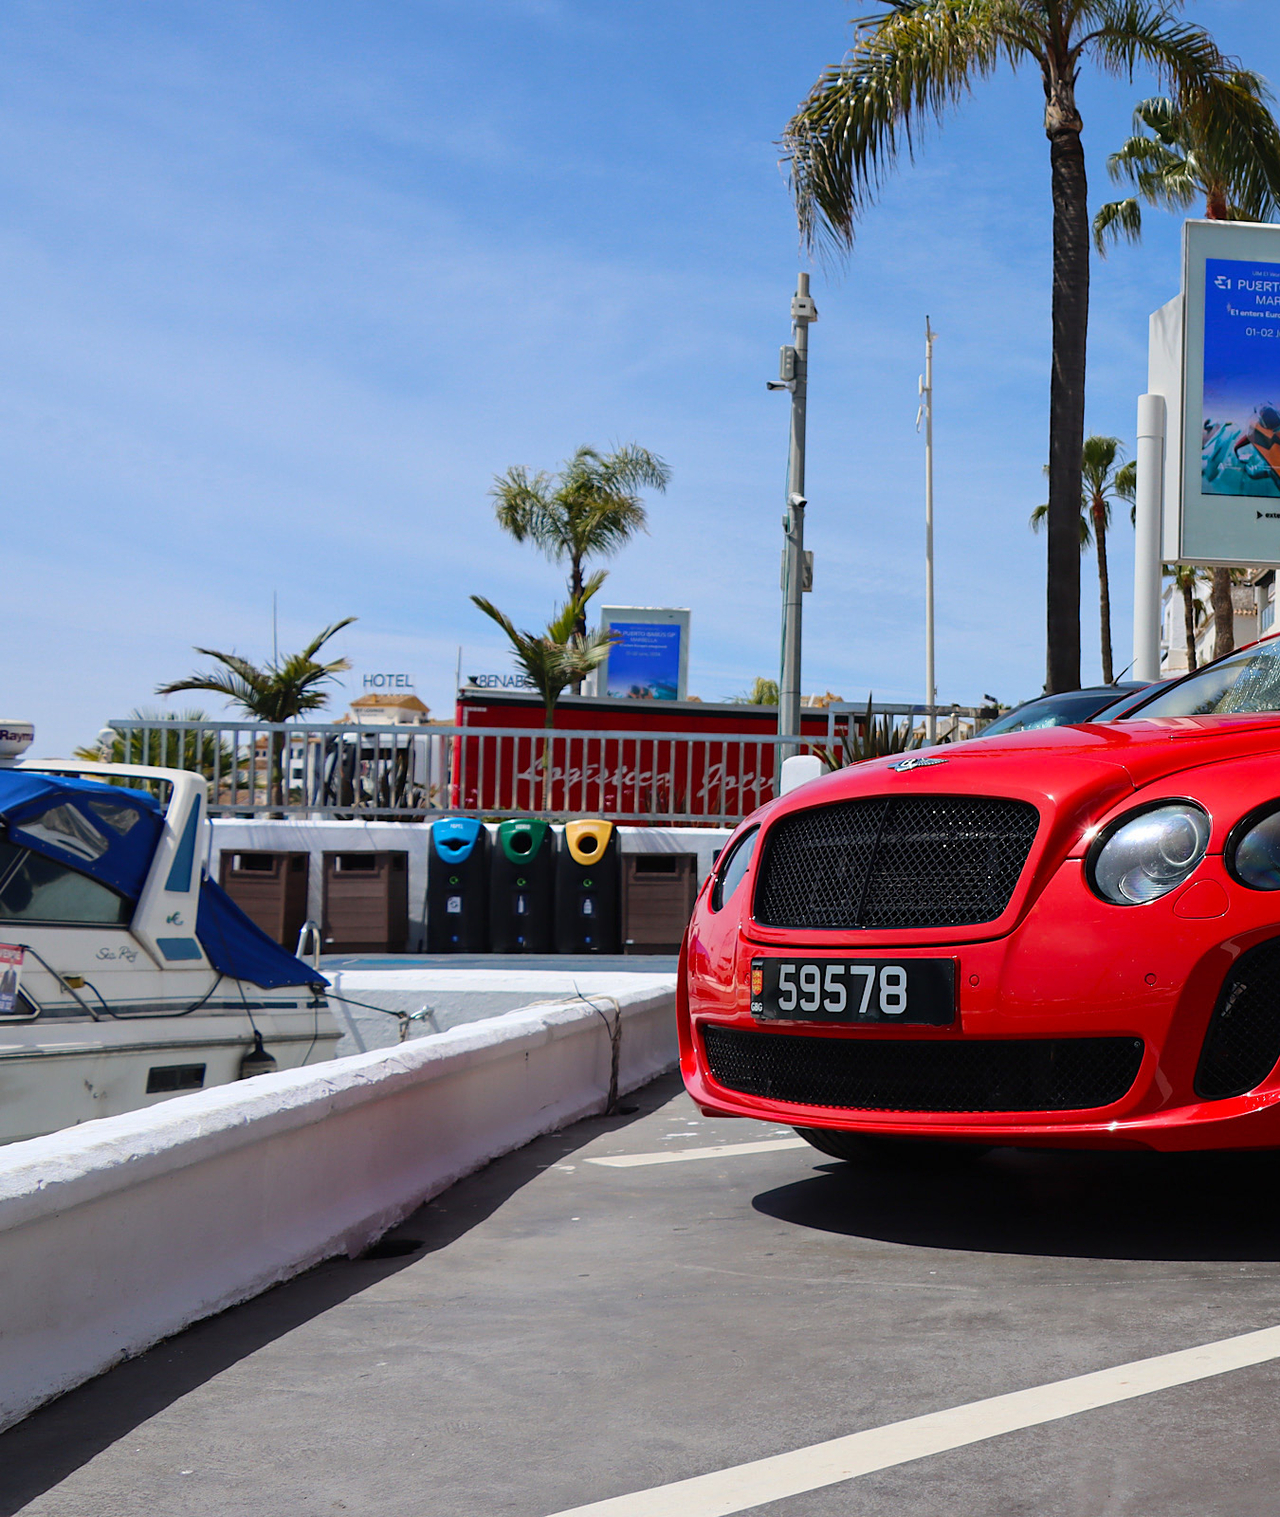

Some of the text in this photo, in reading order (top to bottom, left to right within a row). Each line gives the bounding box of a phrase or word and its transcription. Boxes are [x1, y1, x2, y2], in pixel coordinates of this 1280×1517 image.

[1245, 327, 1274, 338] 01-02
[363, 674, 414, 688] HOTEL
[778, 963, 908, 1014] 59578
[750, 1001, 764, 1012] GBG
